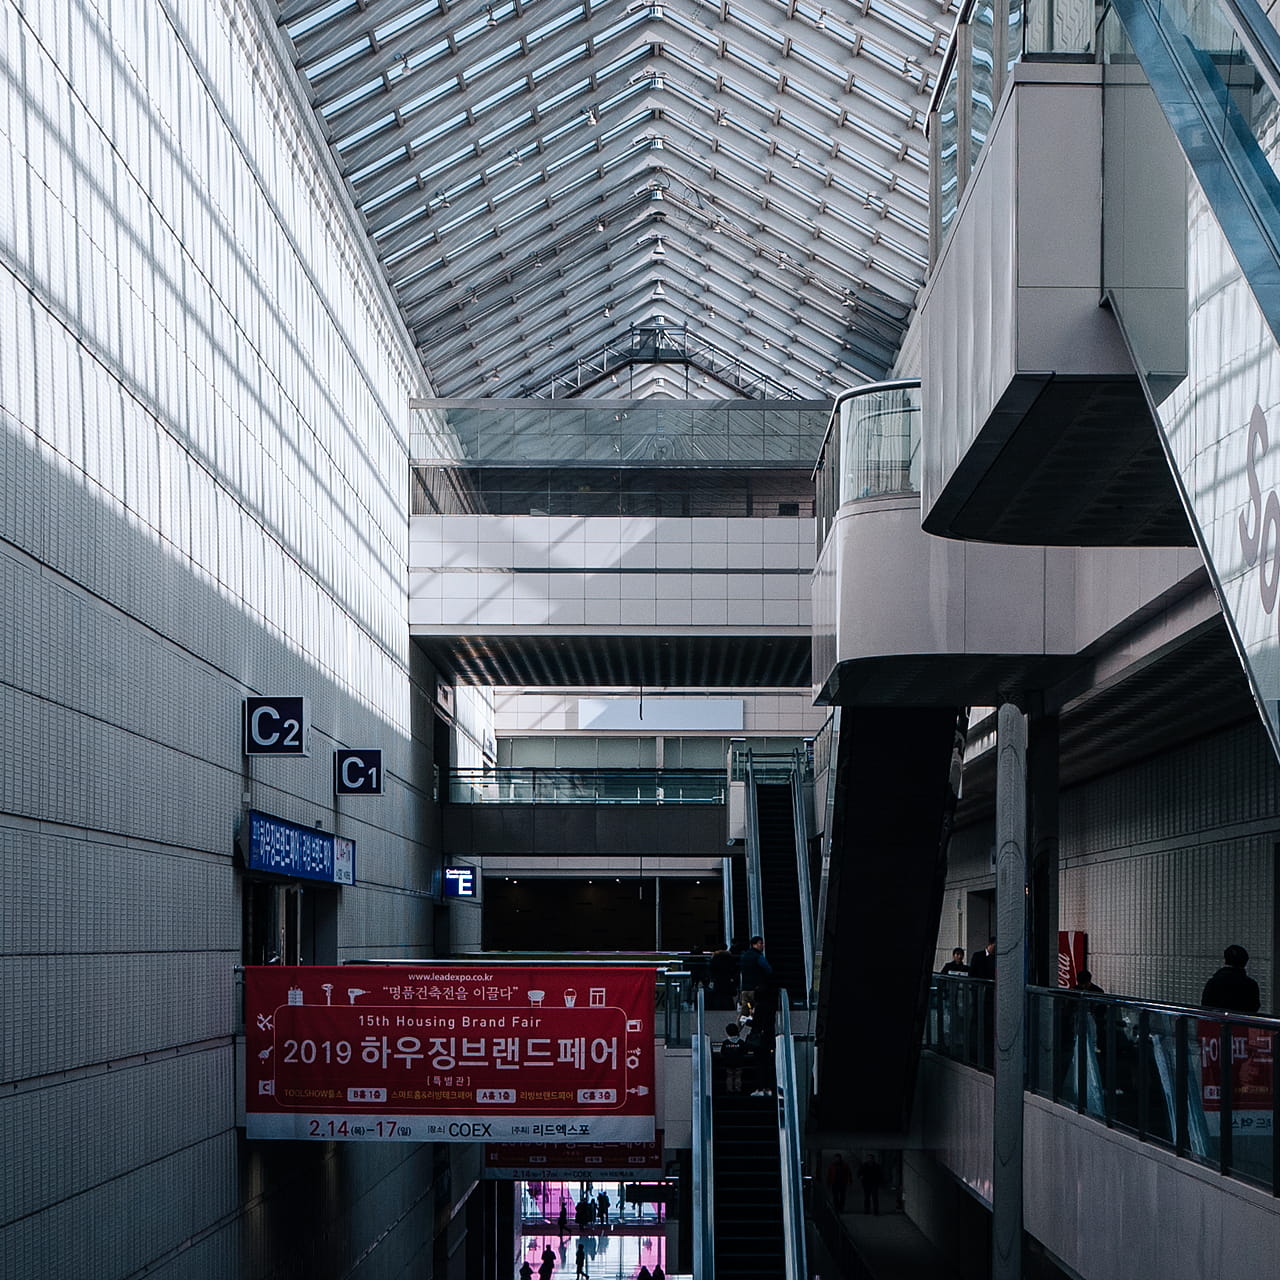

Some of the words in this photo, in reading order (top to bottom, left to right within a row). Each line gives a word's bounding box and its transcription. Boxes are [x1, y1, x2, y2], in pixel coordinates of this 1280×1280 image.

[251, 705, 300, 746] C2
[342, 756, 377, 789] C1
[458, 874, 473, 895] E
[408, 972, 494, 983] www.leadexpo.co.kr
[473, 986, 519, 1001] 이끌다”
[358, 1015, 390, 1027] 15th
[396, 1015, 456, 1029] Housing
[462, 1016, 506, 1028] Brand
[512, 1016, 542, 1028] Fair
[283, 1039, 352, 1064] 2019
[360, 1035, 618, 1071] 하우징브랜드페어
[448, 1122, 492, 1138] COEX
[532, 1124, 590, 1137] 리드엑스포
